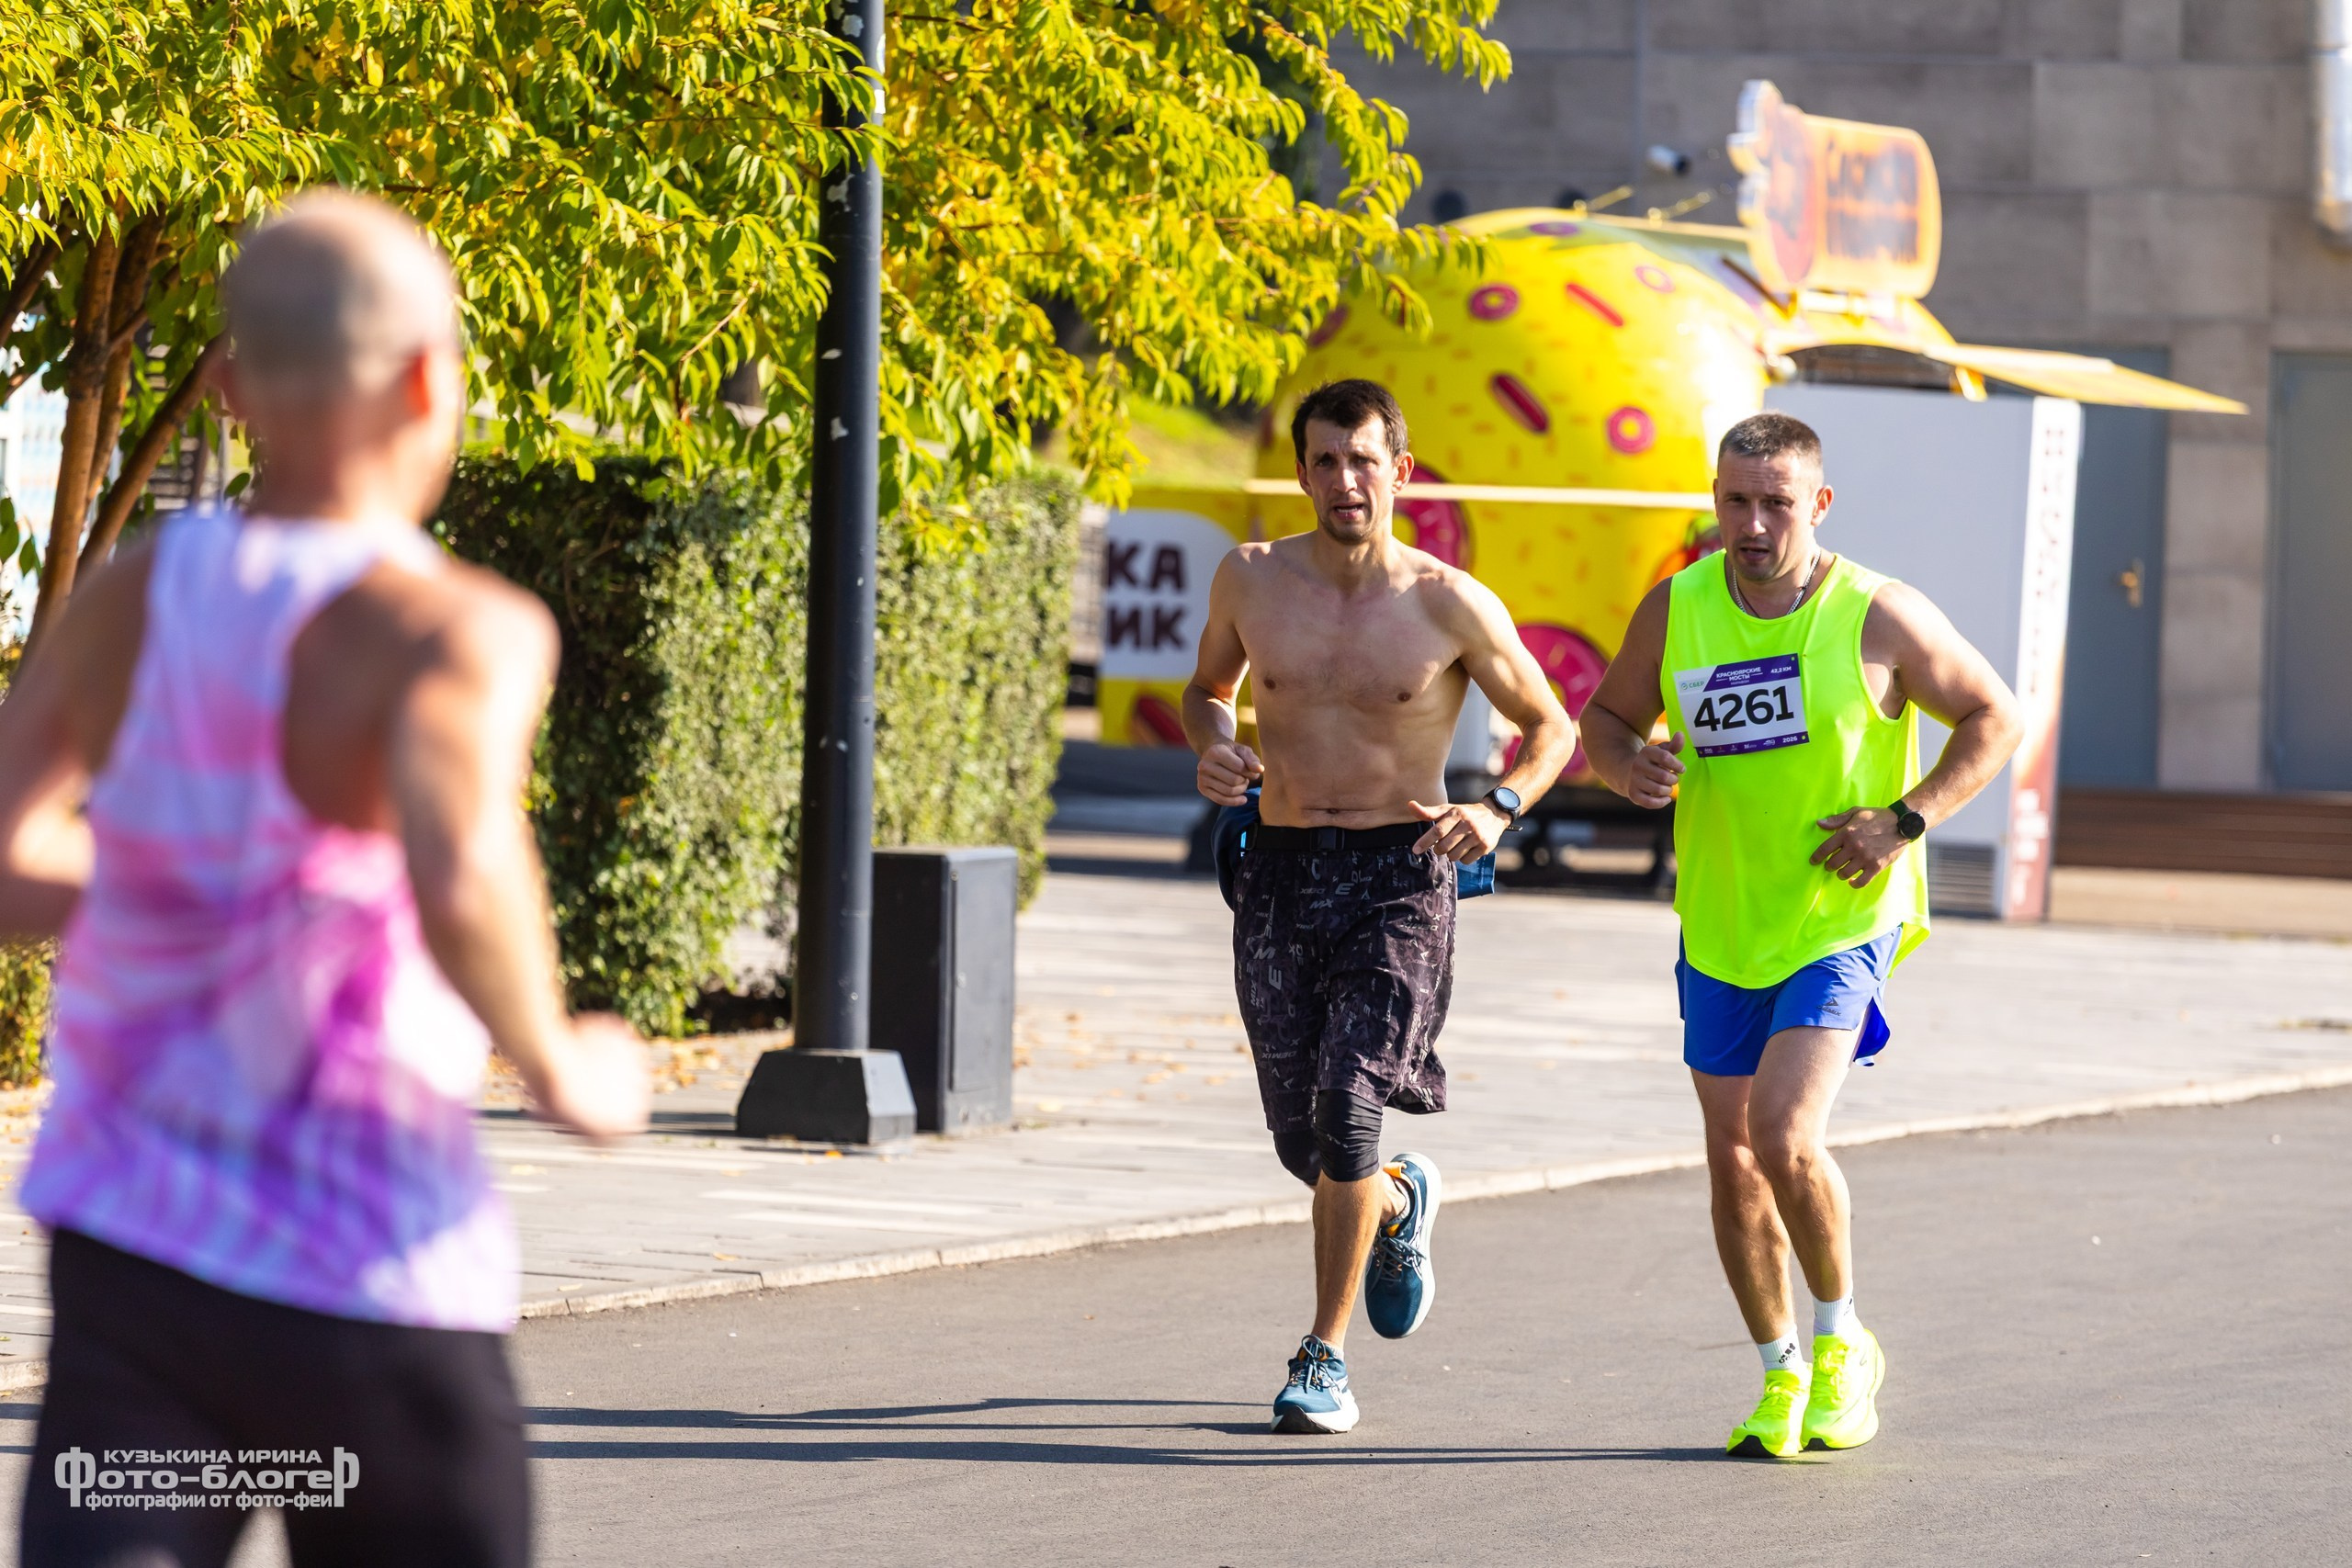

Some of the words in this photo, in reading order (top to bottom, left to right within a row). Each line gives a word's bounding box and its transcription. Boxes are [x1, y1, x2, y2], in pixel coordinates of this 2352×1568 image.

[1715, 667, 1761, 678] КРАСНОЯРСКИЕ
[1728, 673, 1751, 682] МОСТЫ
[1689, 681, 1705, 689] СБЕР
[1693, 685, 1794, 732] 4261
[1261, 1050, 1298, 1059] DEMIX
